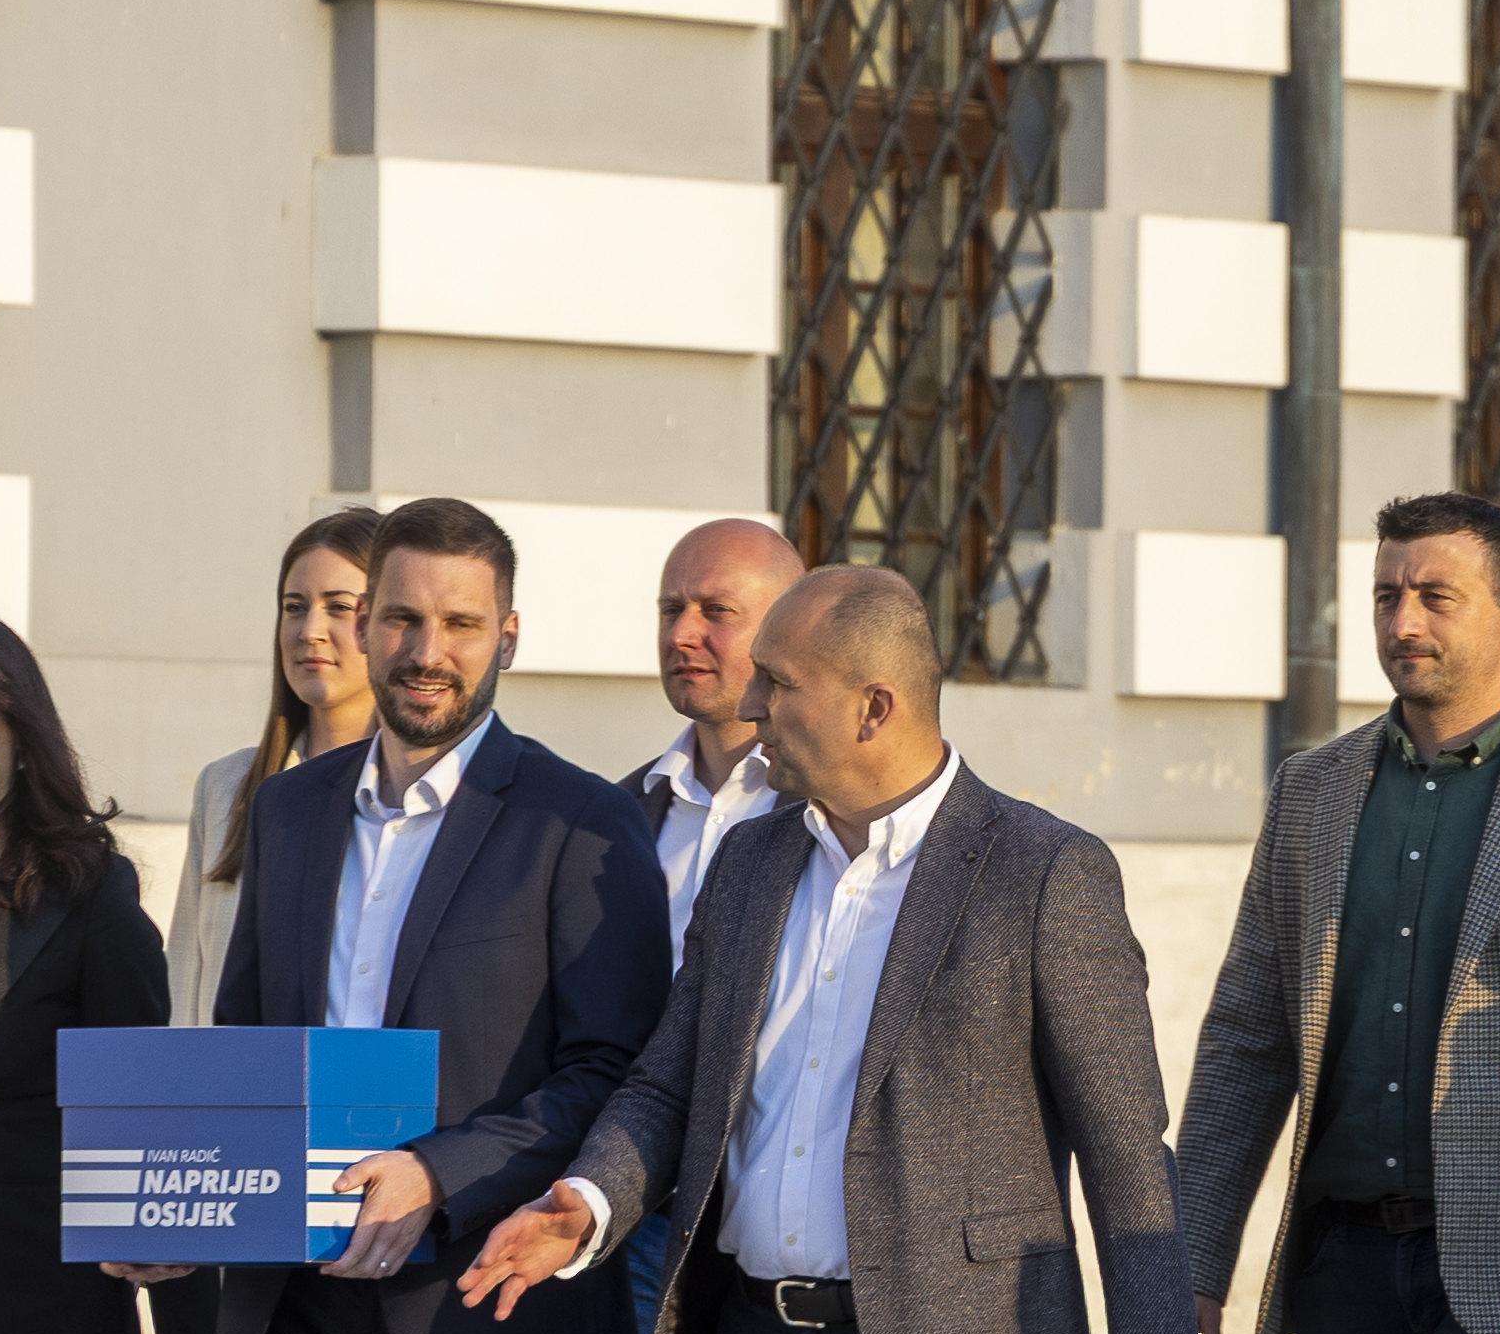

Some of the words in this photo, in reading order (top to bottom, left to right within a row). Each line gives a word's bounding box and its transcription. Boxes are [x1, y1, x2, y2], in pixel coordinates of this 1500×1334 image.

[146, 1149, 179, 1163] IVAN
[180, 1146, 222, 1163] RADIĆ
[142, 1169, 281, 1195] NAPRIJED
[139, 1201, 239, 1227] OSIJEK
